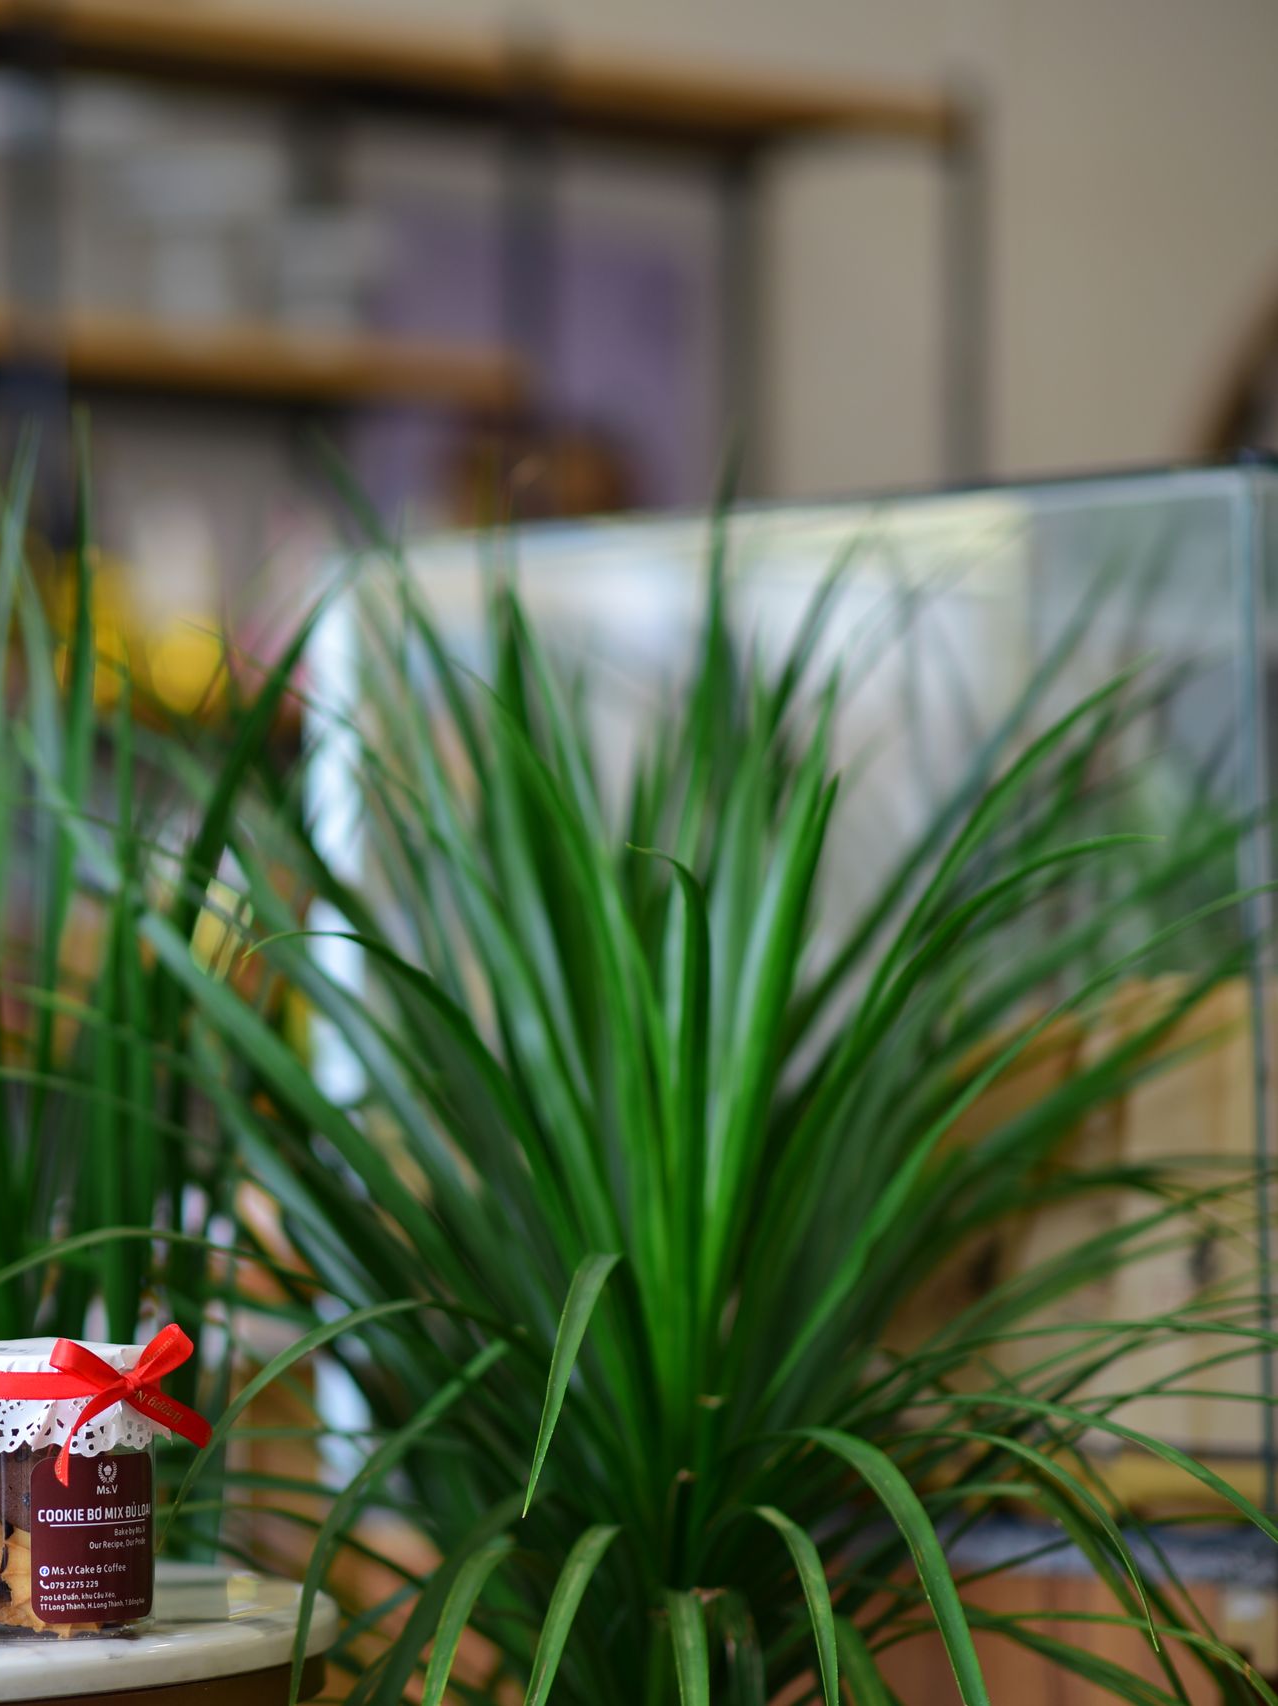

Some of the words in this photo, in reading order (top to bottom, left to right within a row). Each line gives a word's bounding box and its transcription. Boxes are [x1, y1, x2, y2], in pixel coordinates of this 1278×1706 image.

[97, 1485, 118, 1495] Ms.V
[38, 1509, 84, 1522] COOKIE
[105, 1506, 123, 1519] MIX
[114, 1528, 129, 1536] Bake
[103, 1540, 124, 1548] Recipe,
[52, 1566, 72, 1575] Ms.V
[75, 1566, 94, 1574] Cake
[104, 1563, 126, 1572] Coffee
[50, 1581, 64, 1589] 079
[86, 1580, 98, 1588] 229
